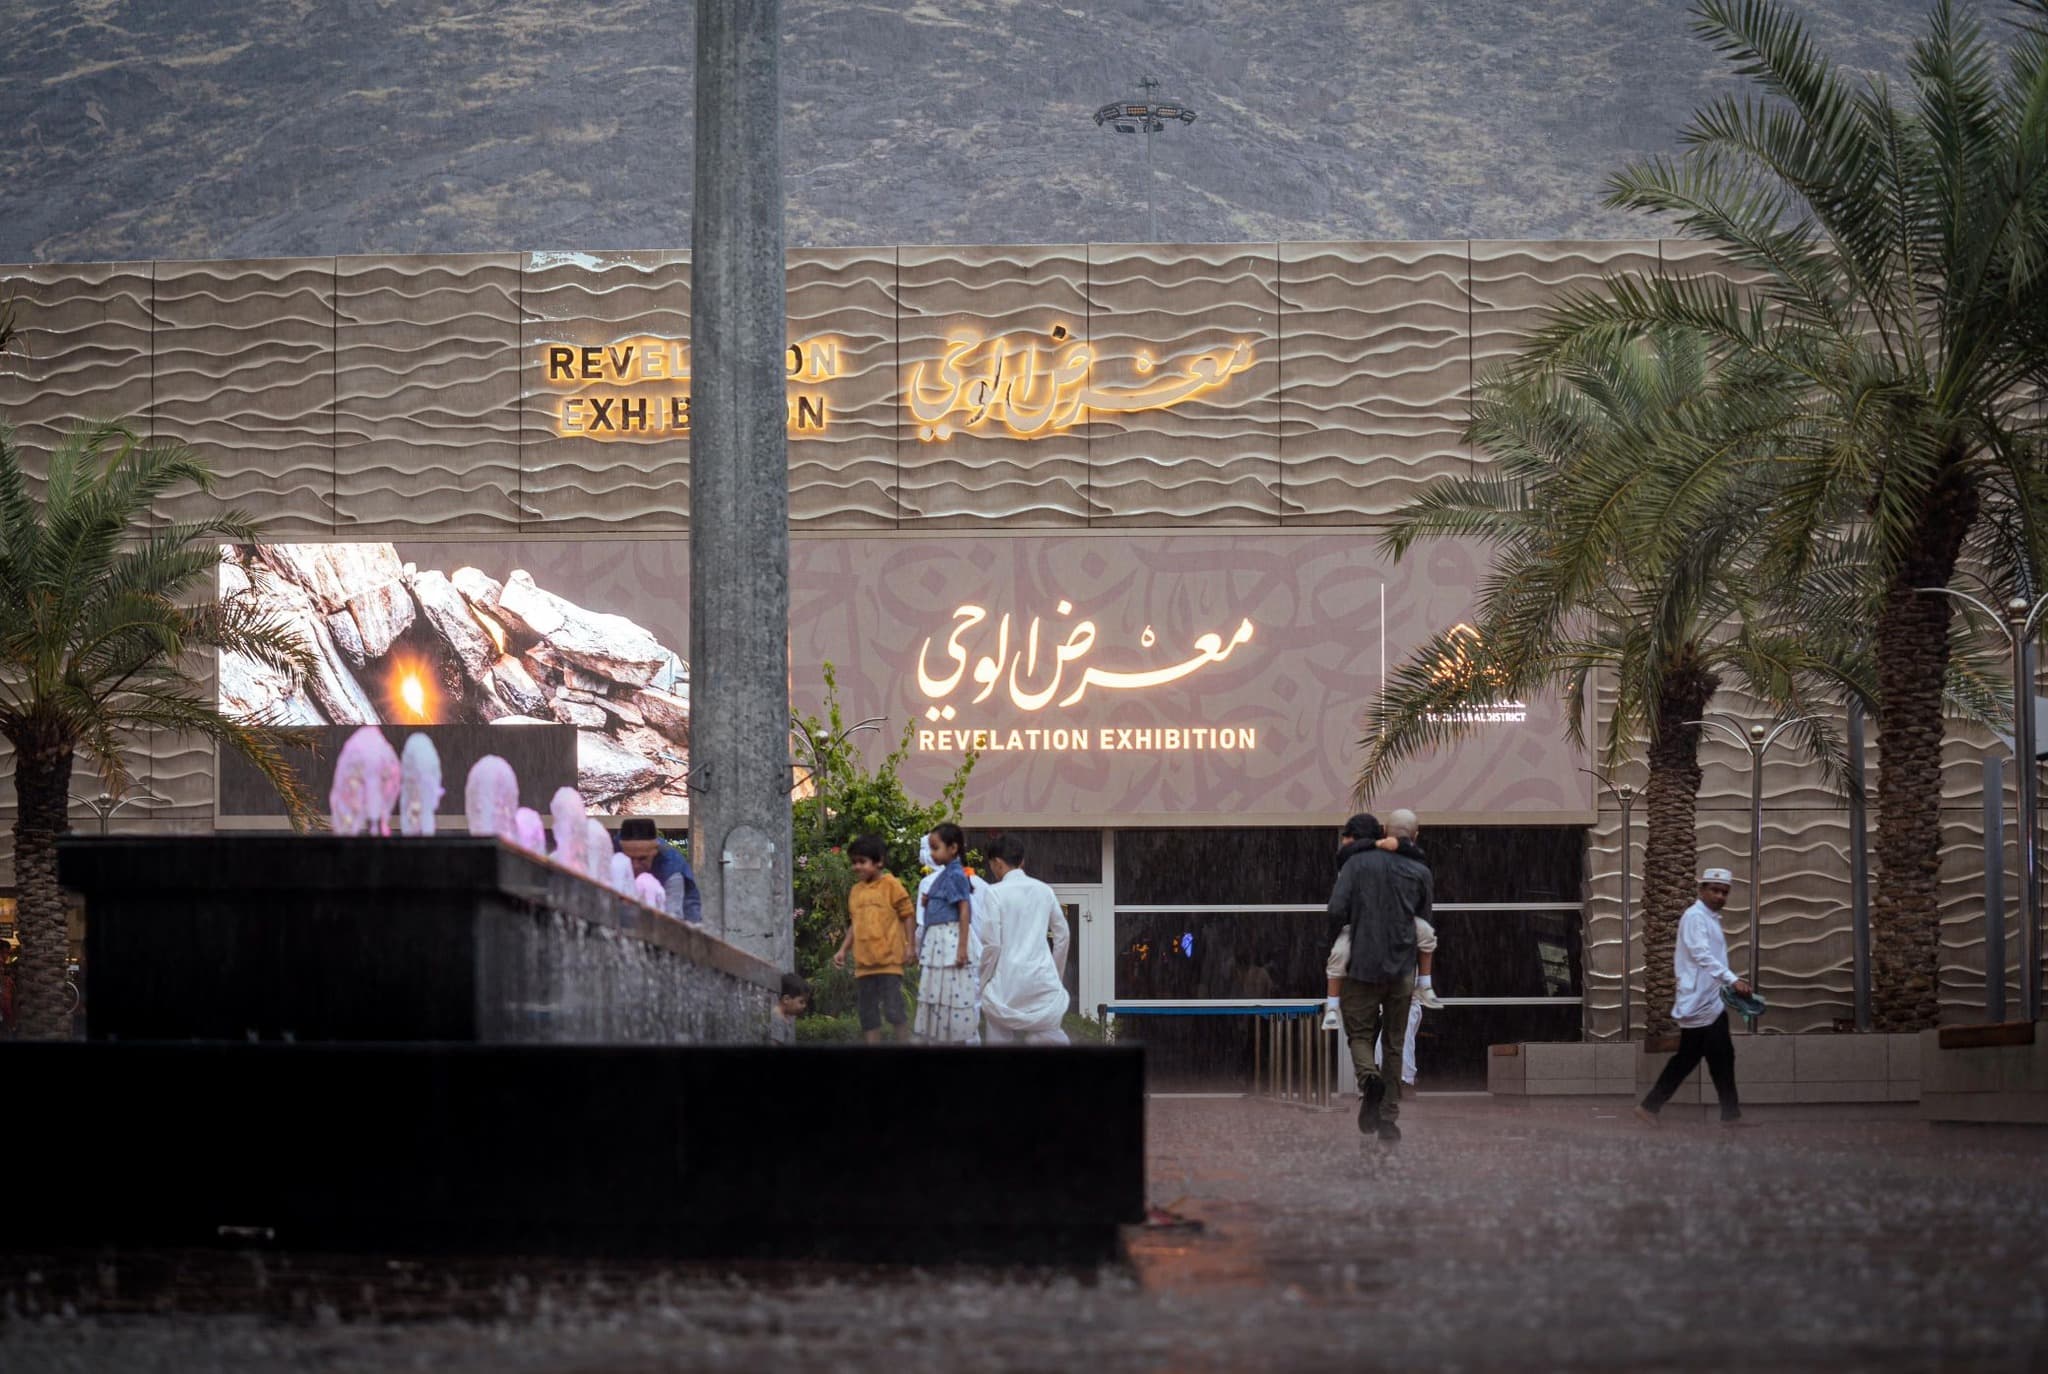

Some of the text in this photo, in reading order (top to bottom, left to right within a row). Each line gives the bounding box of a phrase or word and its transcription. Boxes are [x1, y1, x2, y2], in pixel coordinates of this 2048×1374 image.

[549, 344, 836, 379] REVELON
[1004, 325, 1252, 433] معرض
[561, 396, 824, 431] EXHIBN
[1008, 600, 1254, 711] معرض
[919, 727, 1256, 751] REVELATION EXHIBITION
